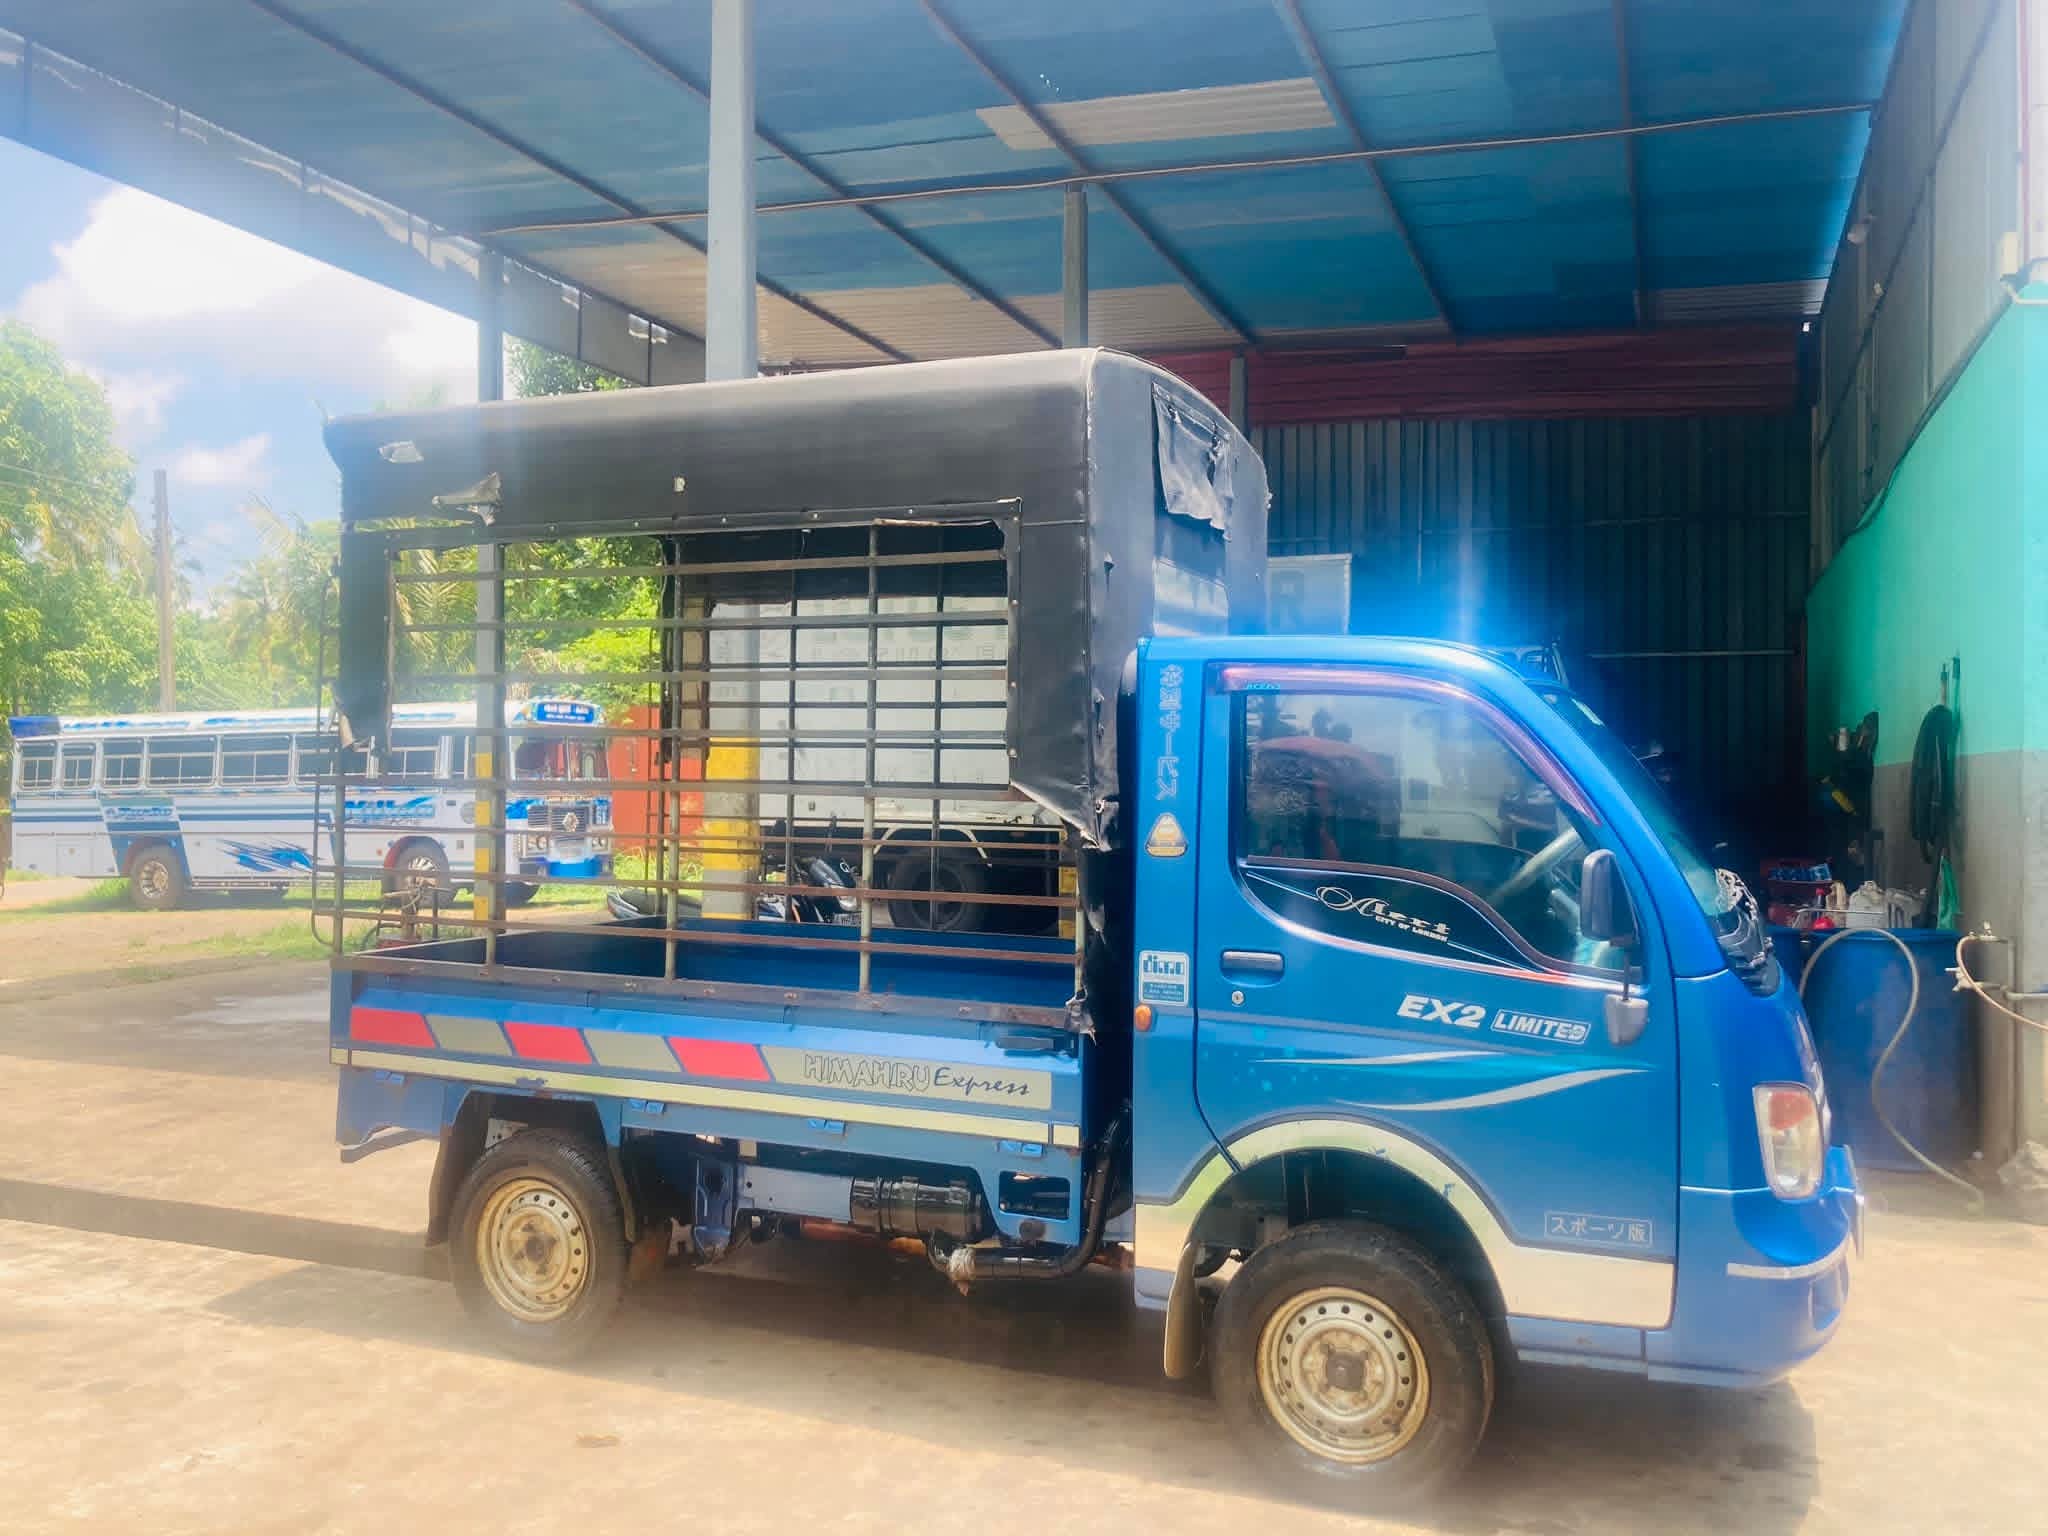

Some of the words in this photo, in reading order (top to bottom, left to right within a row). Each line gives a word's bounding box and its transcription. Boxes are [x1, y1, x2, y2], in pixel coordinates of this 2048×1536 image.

[1412, 926, 1448, 943] LONDON
[1397, 993, 1486, 1029] EX2
[1493, 1011, 1587, 1042] LIMITED
[933, 1066, 1031, 1096] Express
[1551, 1215, 1646, 1241] スポーツ版
